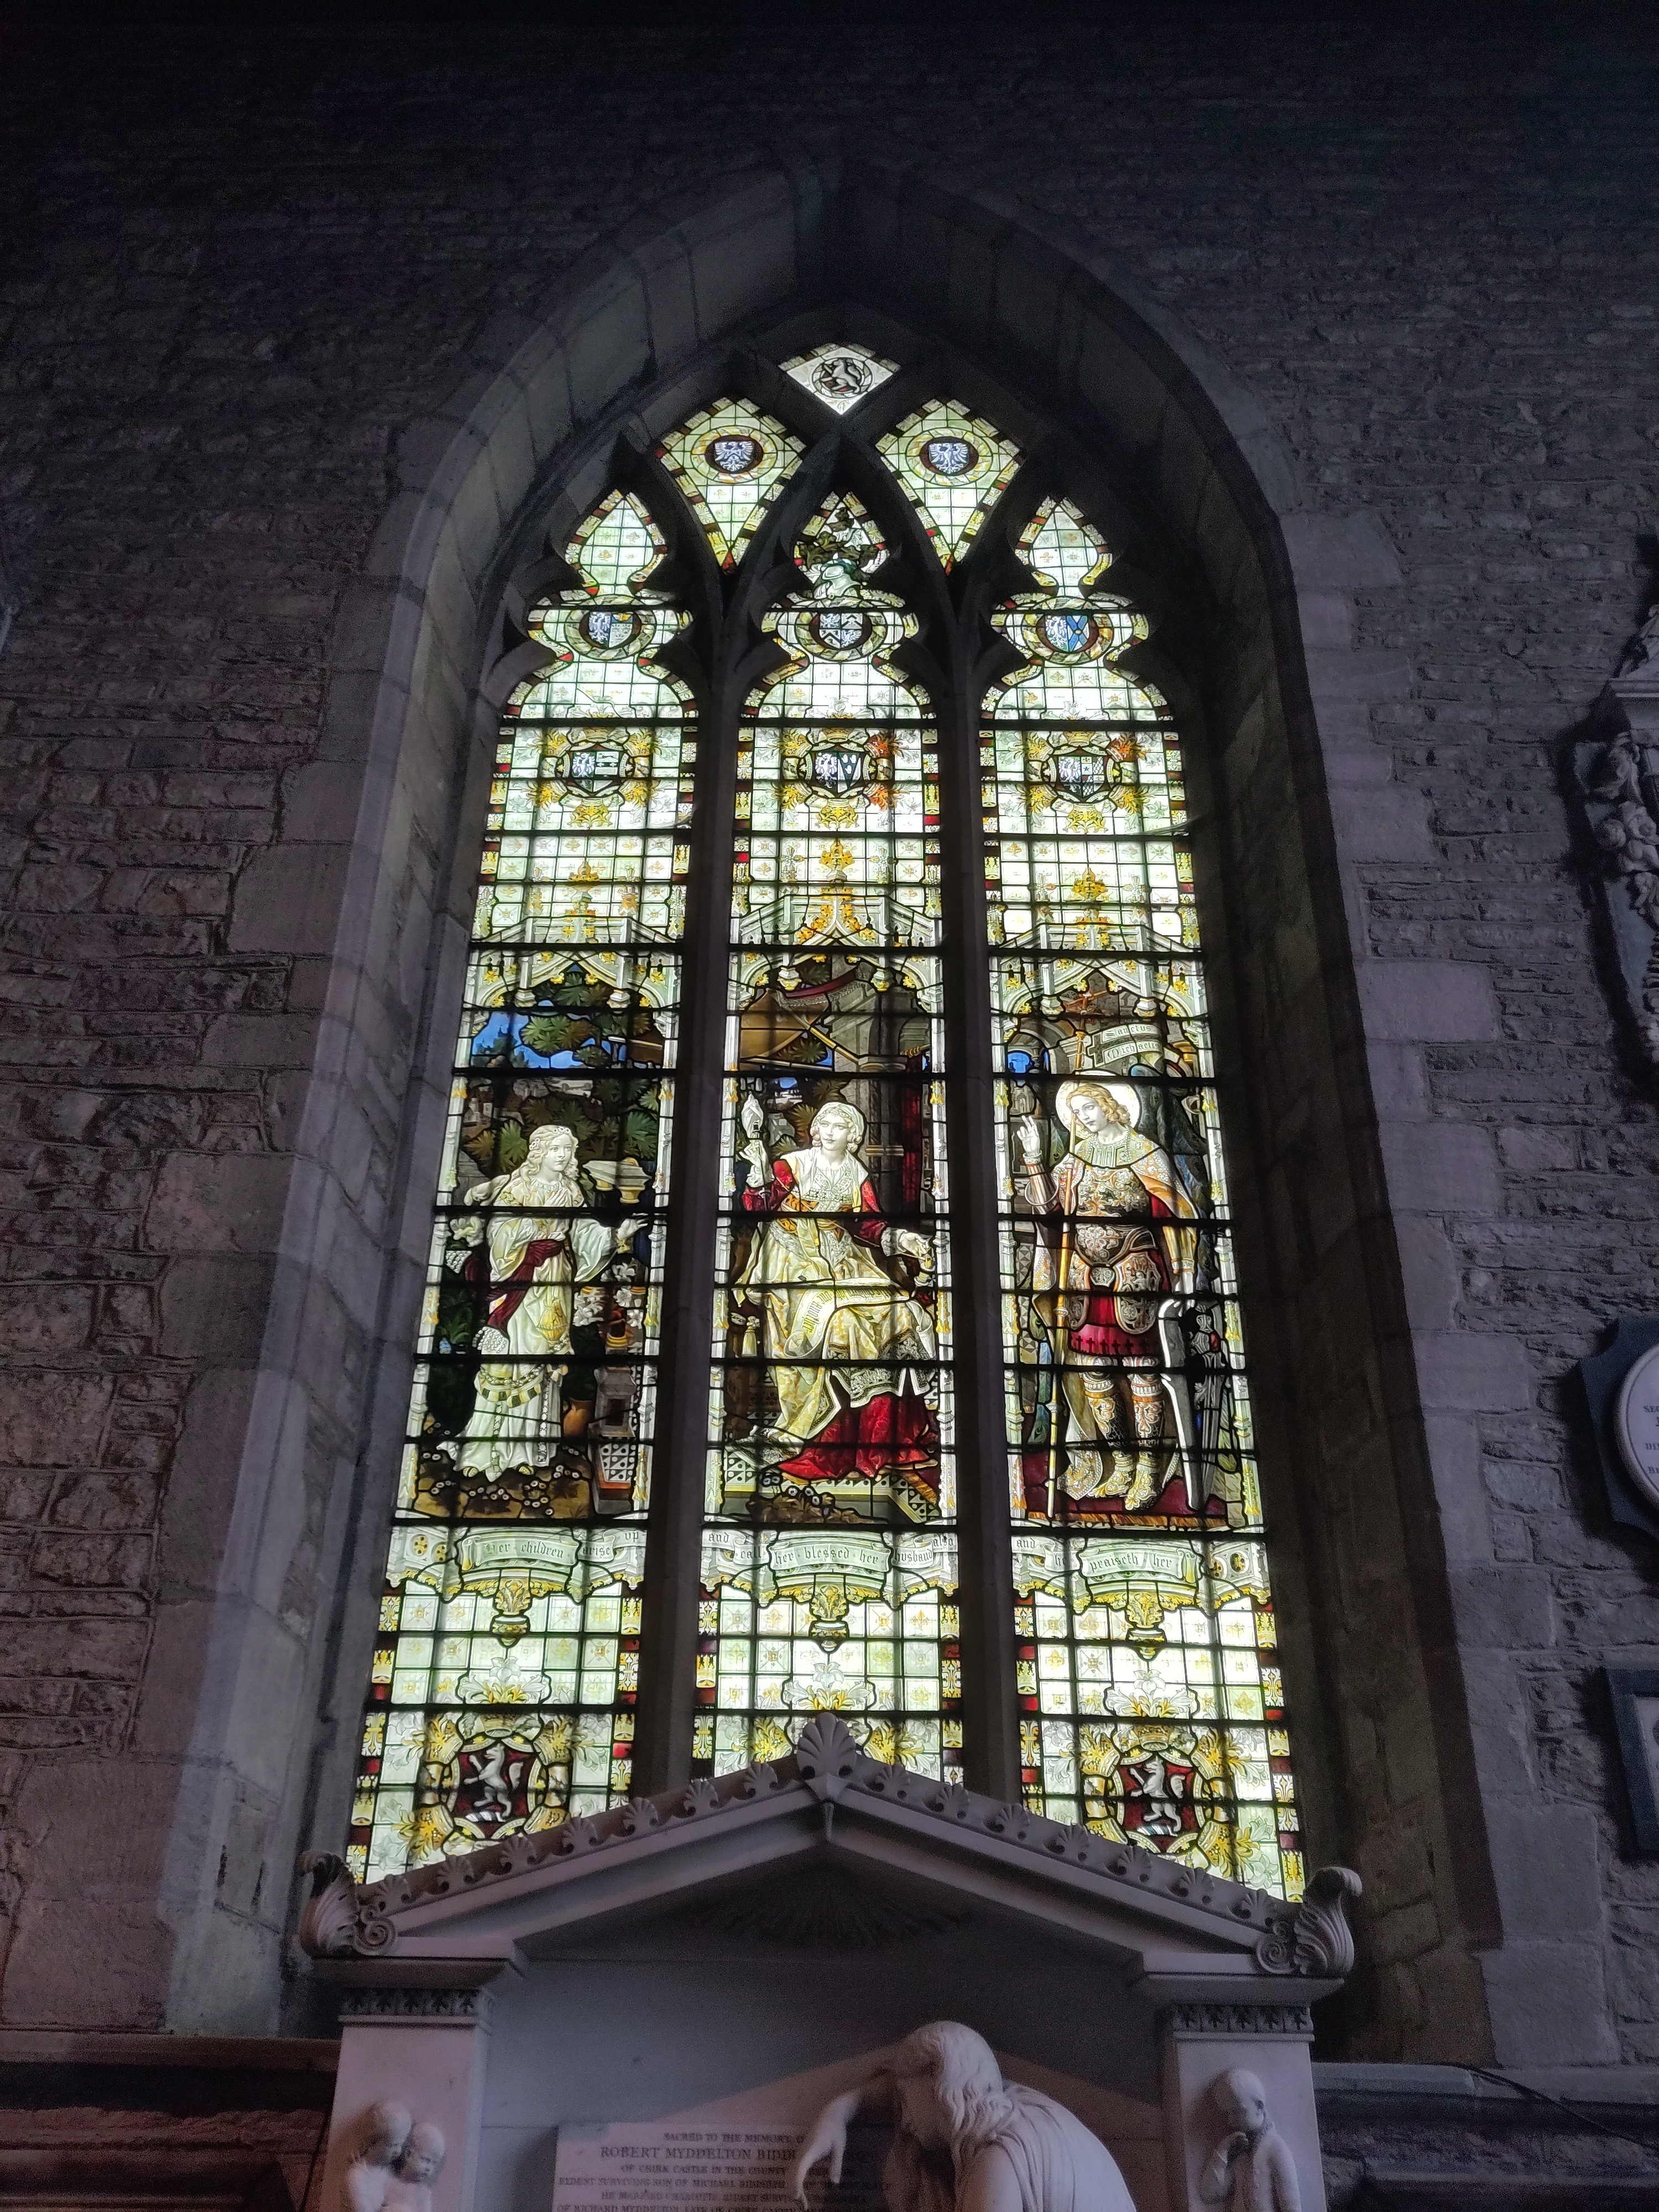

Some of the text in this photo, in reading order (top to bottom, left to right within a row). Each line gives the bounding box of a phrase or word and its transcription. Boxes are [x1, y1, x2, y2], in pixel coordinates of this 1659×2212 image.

[1105, 1025, 1151, 1040] Sanctus
[1107, 1042, 1160, 1059] Michaelis
[486, 1543, 510, 1554] Her
[521, 1540, 564, 1558] children
[582, 1545, 611, 1557] arise
[708, 1532, 954, 1565] and call her blessed her husband also
[1016, 1537, 1172, 1574] and he praiseth her
[663, 2133, 703, 2142] SACRED
[745, 2135, 790, 2143] MEMORY
[601, 2146, 795, 2161] ROBERT MYDDELTON BIDD
[620, 2164, 785, 2175] OF CHIRK CASTLE IN THE COUNTY
[653, 2178, 672, 2187] SON
[675, 2179, 688, 2187] OF
[693, 2179, 734, 2188] MICHAEL
